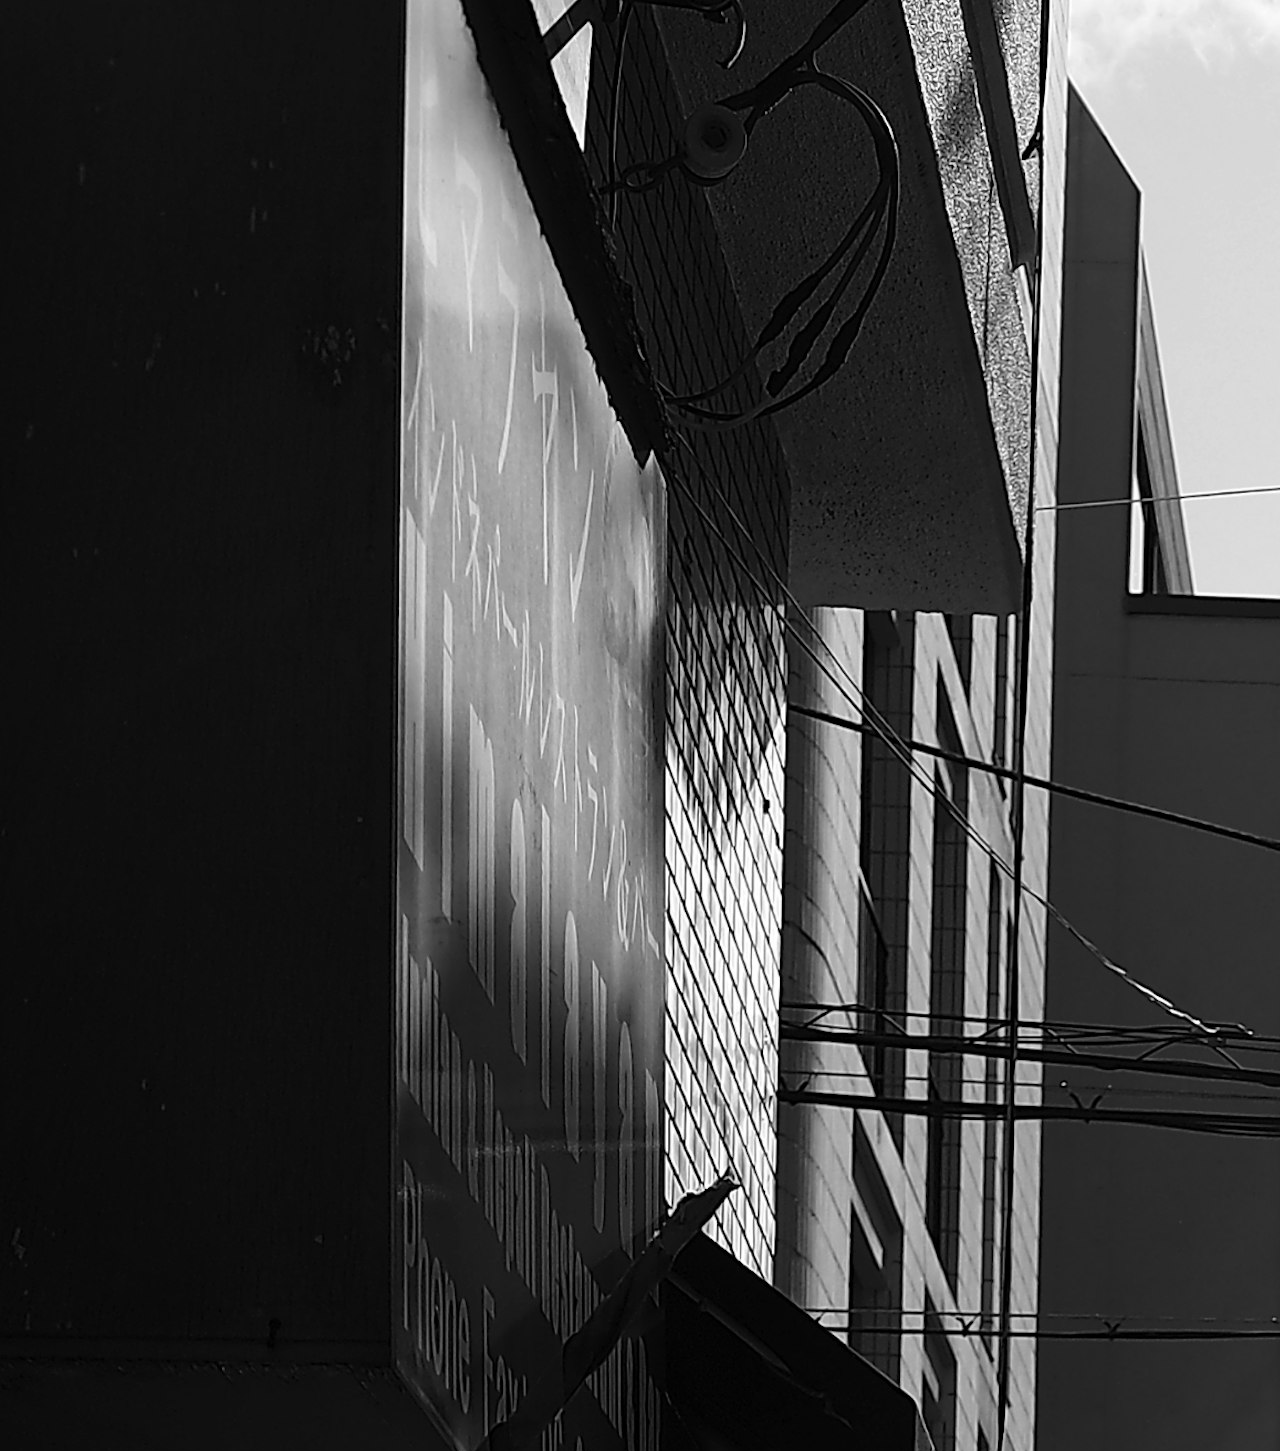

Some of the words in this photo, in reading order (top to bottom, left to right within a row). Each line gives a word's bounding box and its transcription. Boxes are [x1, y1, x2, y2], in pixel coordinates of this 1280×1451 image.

[403, 508, 662, 1308] Himalayan
[402, 913, 462, 1175] Indian
[468, 1058, 479, 1203] &
[482, 1060, 537, 1298] Nepali
[402, 1158, 471, 1414] Phone
